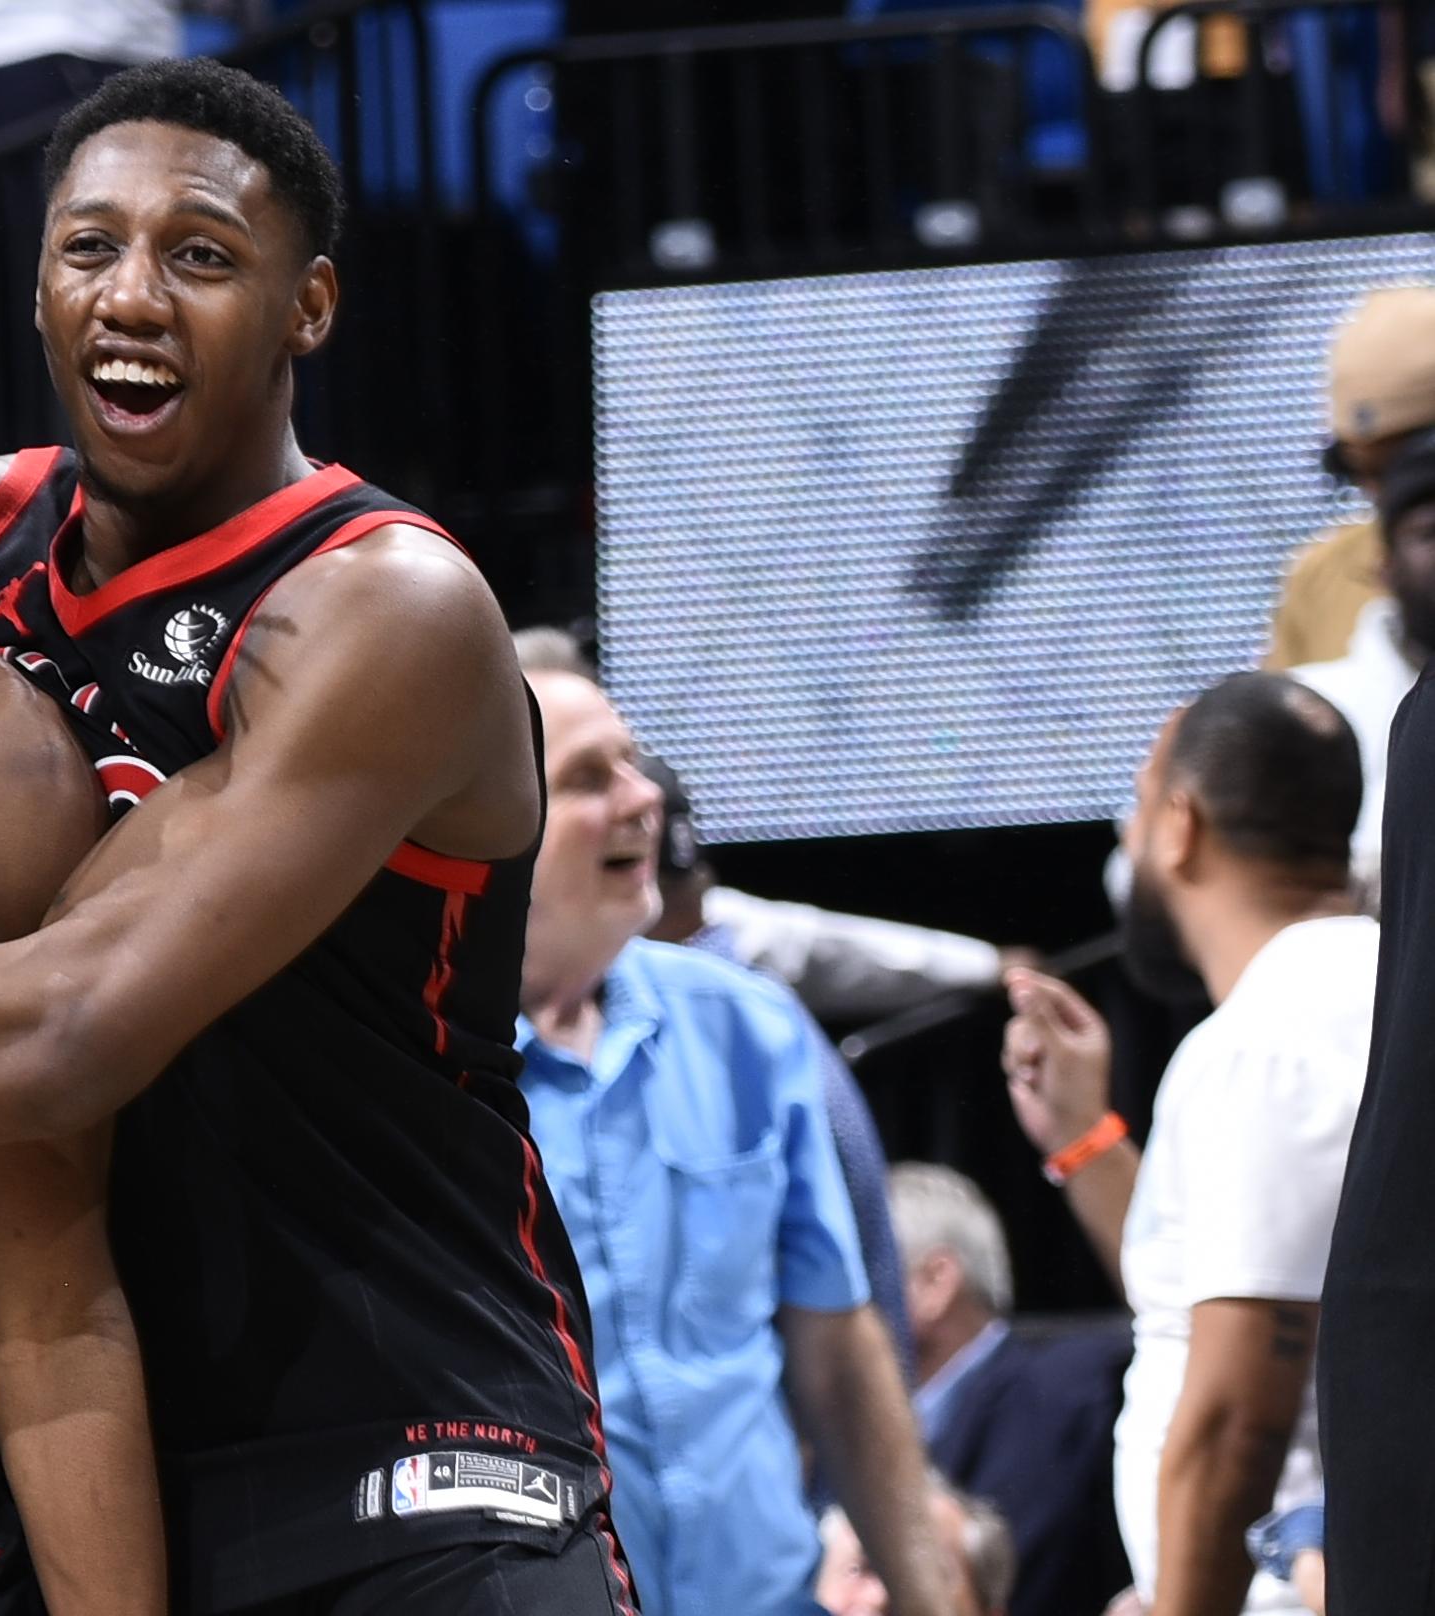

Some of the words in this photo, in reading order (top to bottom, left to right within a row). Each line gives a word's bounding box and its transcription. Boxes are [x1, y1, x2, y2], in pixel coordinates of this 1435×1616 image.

[128, 652, 173, 685] Sun
[405, 1424, 427, 1442] WE
[434, 1421, 470, 1439] THE
[474, 1423, 537, 1454] NORTH
